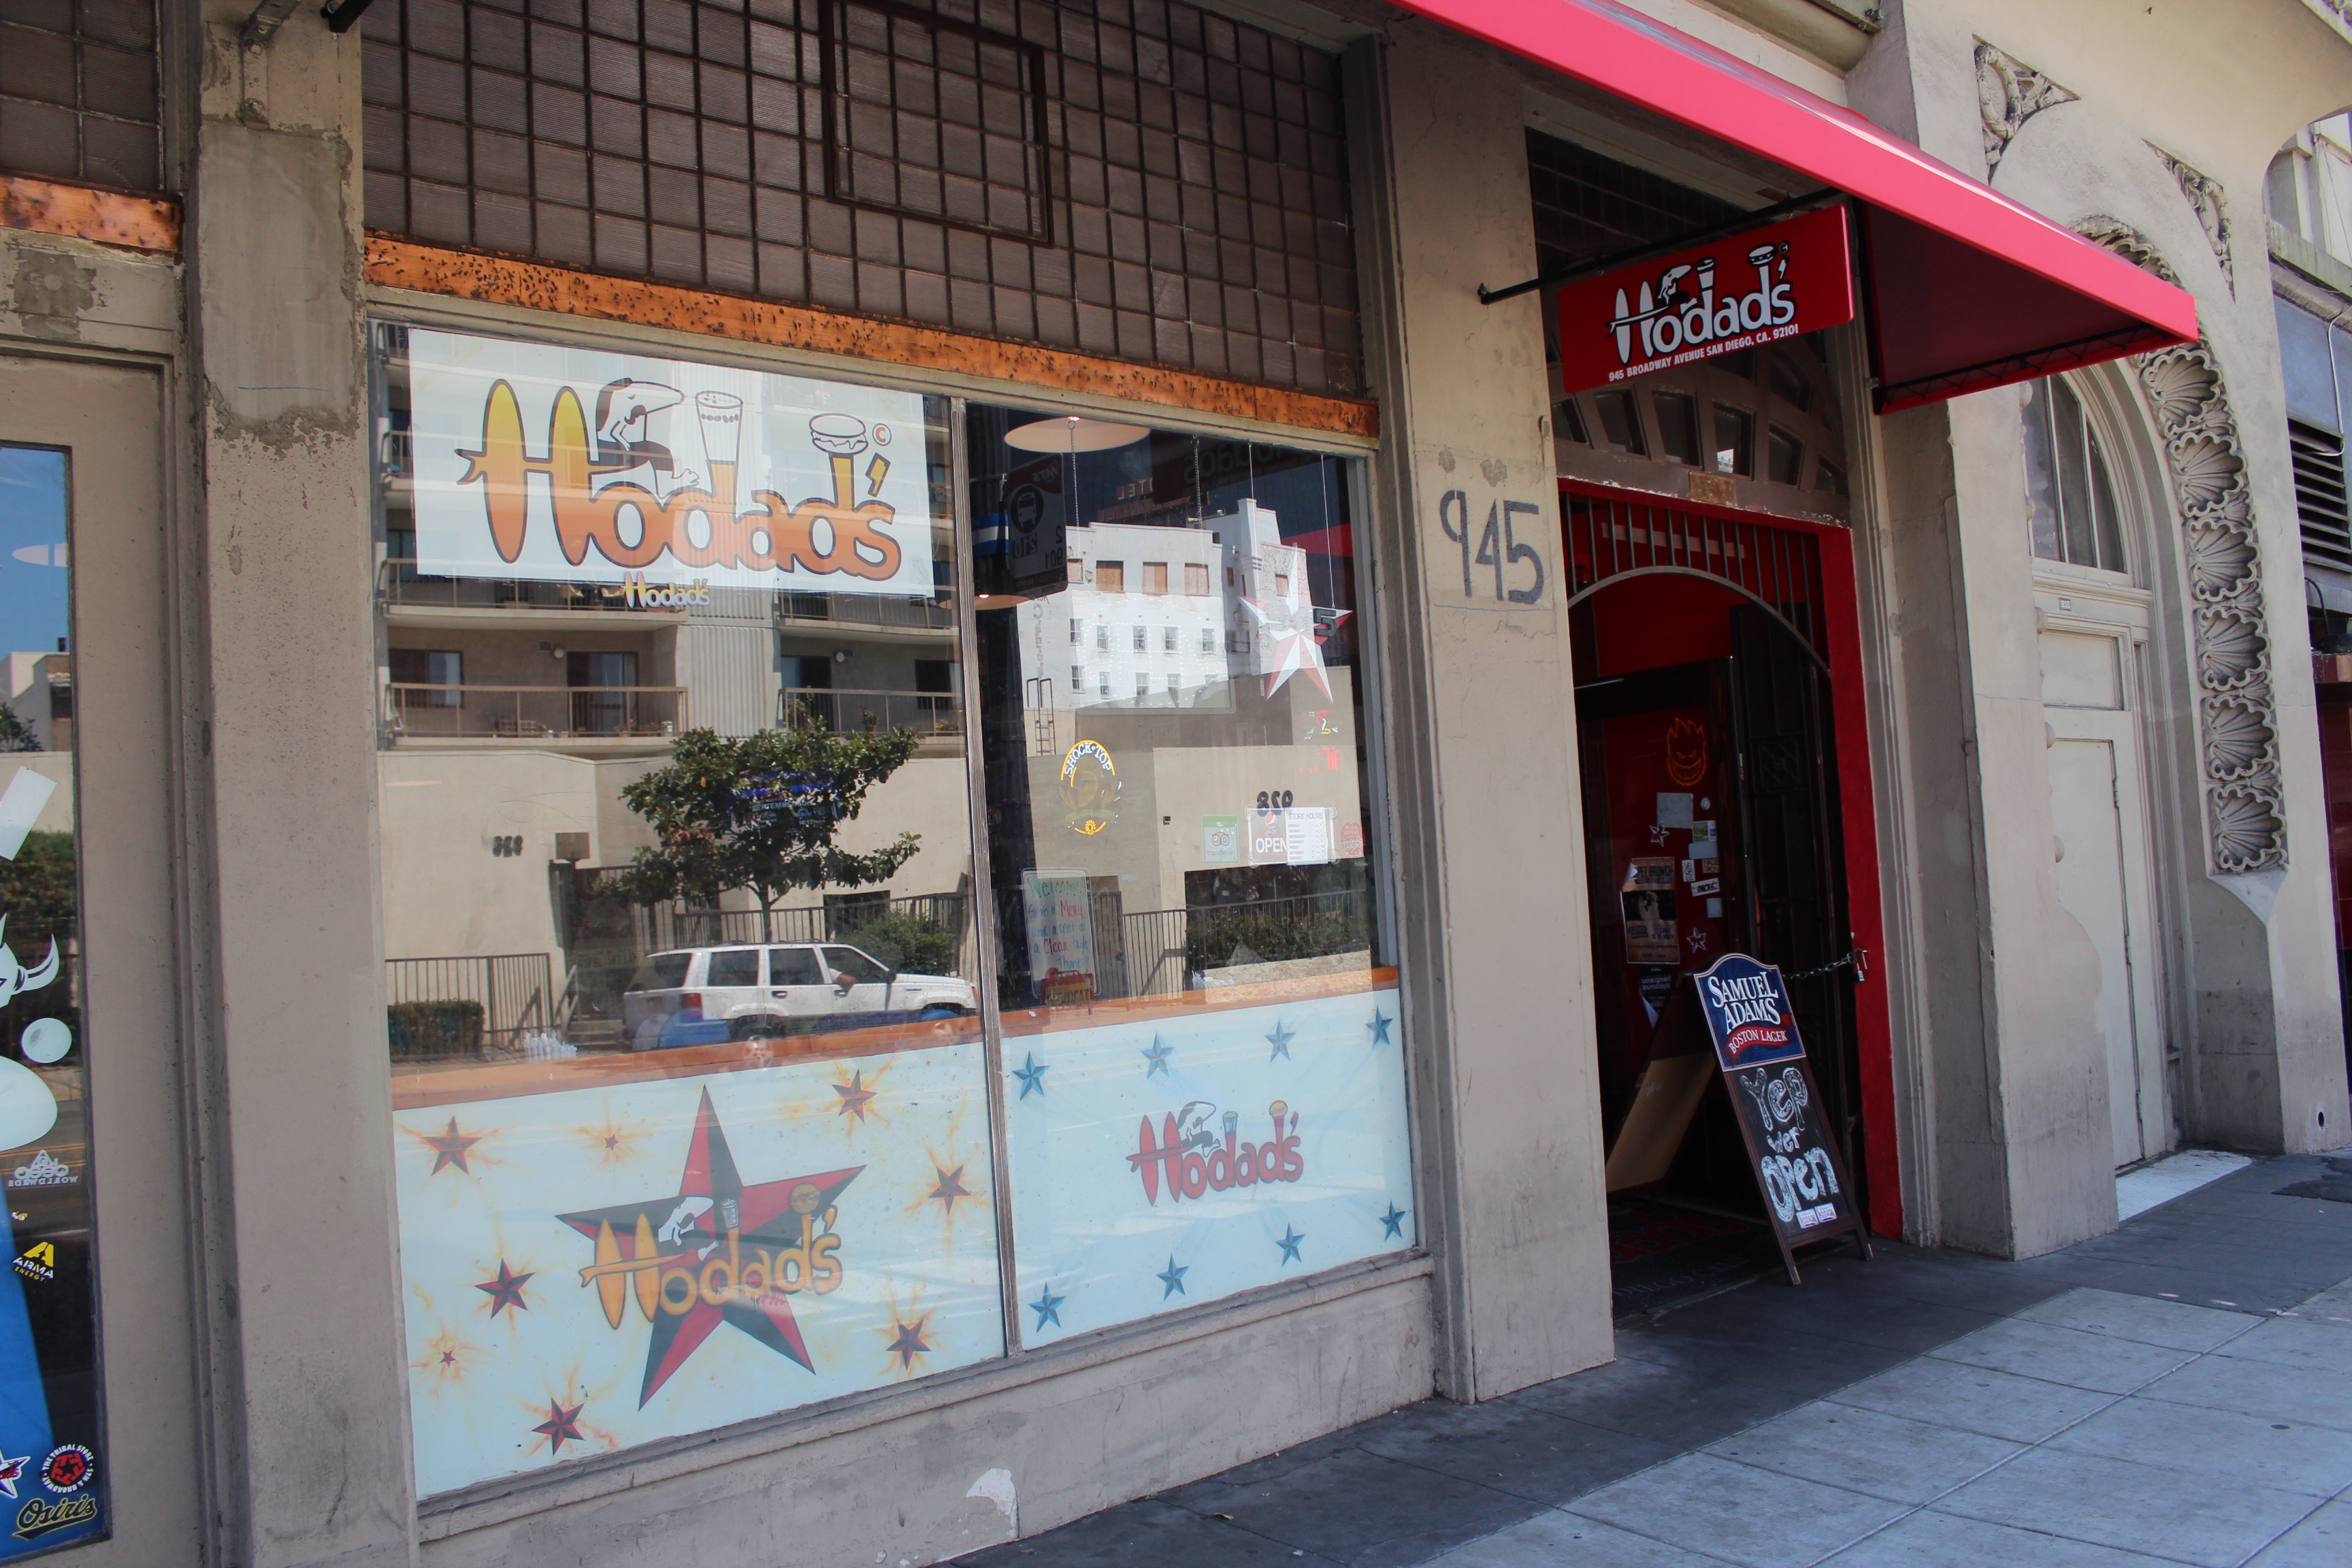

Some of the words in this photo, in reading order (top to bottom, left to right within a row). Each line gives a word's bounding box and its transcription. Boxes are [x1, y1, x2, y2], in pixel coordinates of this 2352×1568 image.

[1608, 368, 1625, 382] 945
[1627, 357, 1672, 378] BROADWAY
[1674, 347, 1705, 366] AVENUE
[1706, 342, 1724, 356] SAN
[1725, 336, 1755, 352] DIEGO,
[1772, 323, 1799, 340] 92101
[1439, 489, 1545, 604] 945
[1064, 742, 1093, 777] SHOCK
[1094, 745, 1111, 770] TOP
[1256, 837, 1287, 853] OPEN
[1708, 971, 1778, 1008] SAMUEL
[1725, 998, 1781, 1035] ADAMS
[1728, 1030, 1759, 1055] BOSTON
[1760, 1030, 1786, 1043] LAGER
[12, 1257, 54, 1279] ARMA
[14, 1266, 46, 1282] ENERGY
[42, 1455, 54, 1471] THE
[50, 1443, 76, 1458] TRIBAL
[76, 1445, 94, 1462] STORE
[42, 1475, 78, 1494] BROADWAY
[14, 1494, 97, 1535] Osiris
